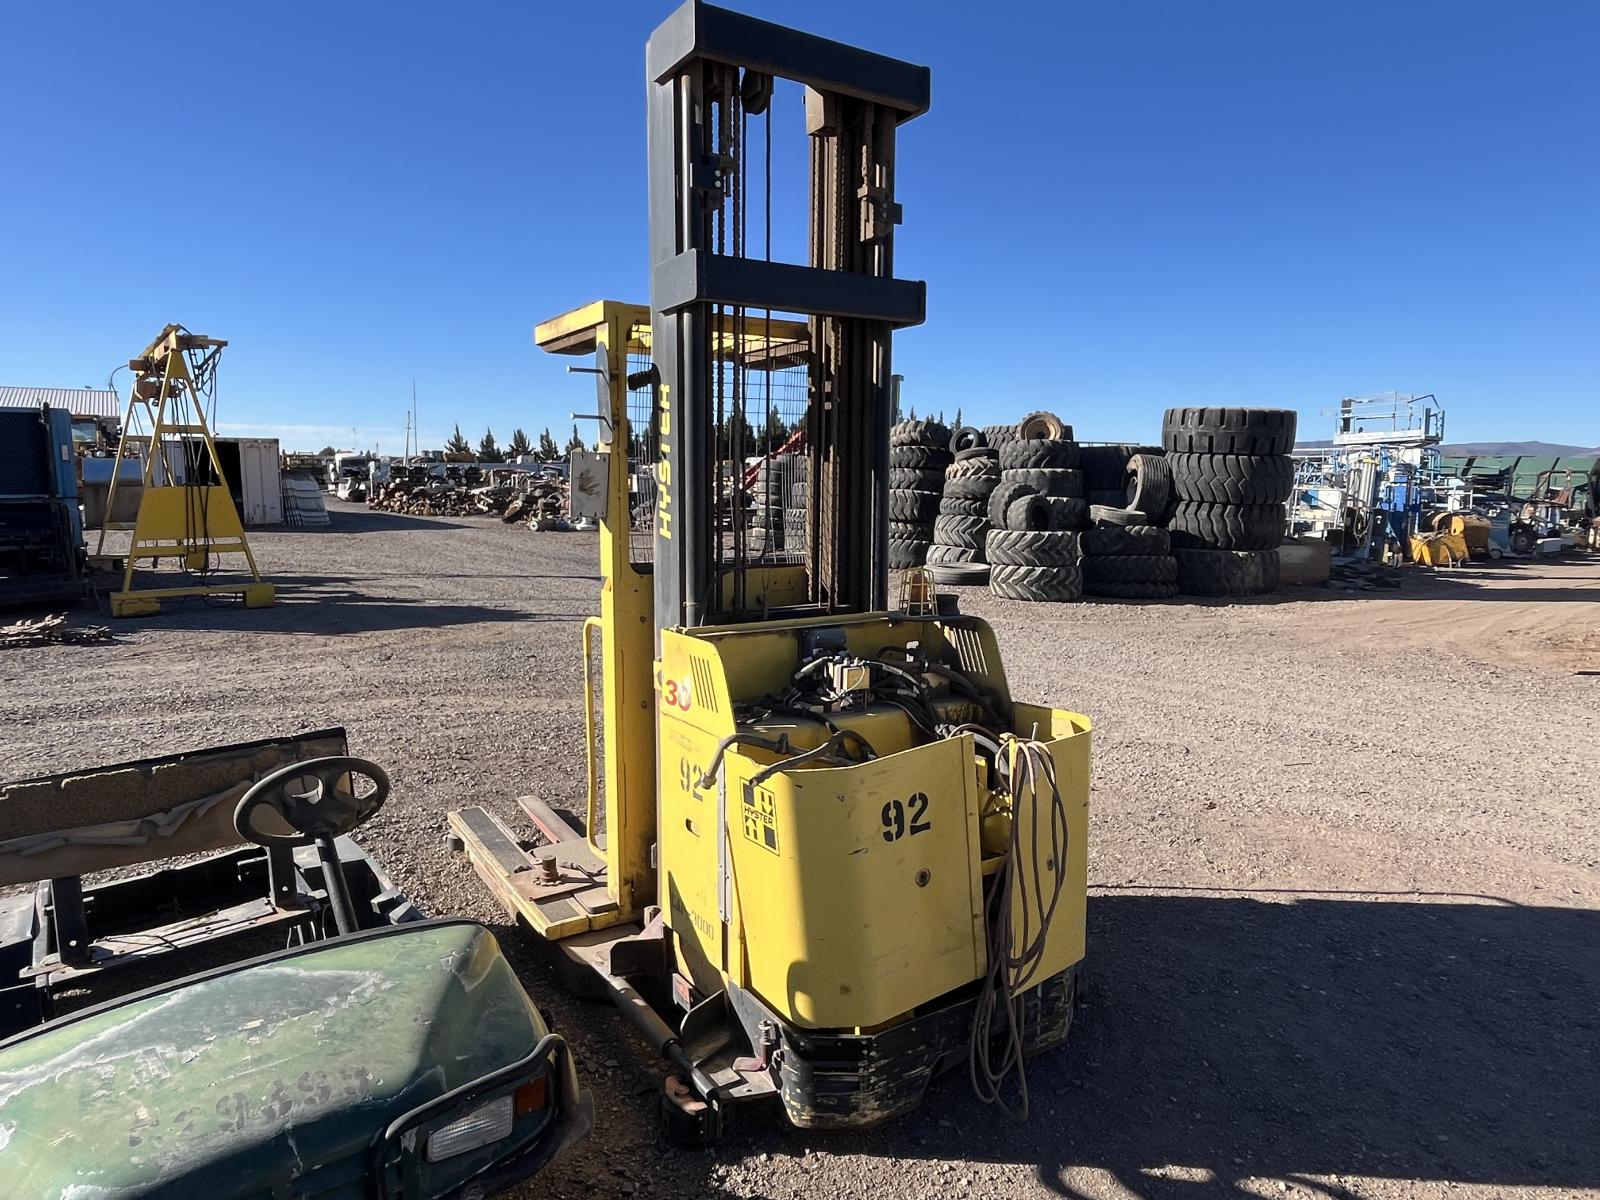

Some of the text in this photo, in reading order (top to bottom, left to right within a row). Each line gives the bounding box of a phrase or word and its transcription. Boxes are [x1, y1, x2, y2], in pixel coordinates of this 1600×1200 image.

[680, 756, 704, 802] 92
[744, 805, 774, 827] HYSTER
[881, 792, 931, 842] 92
